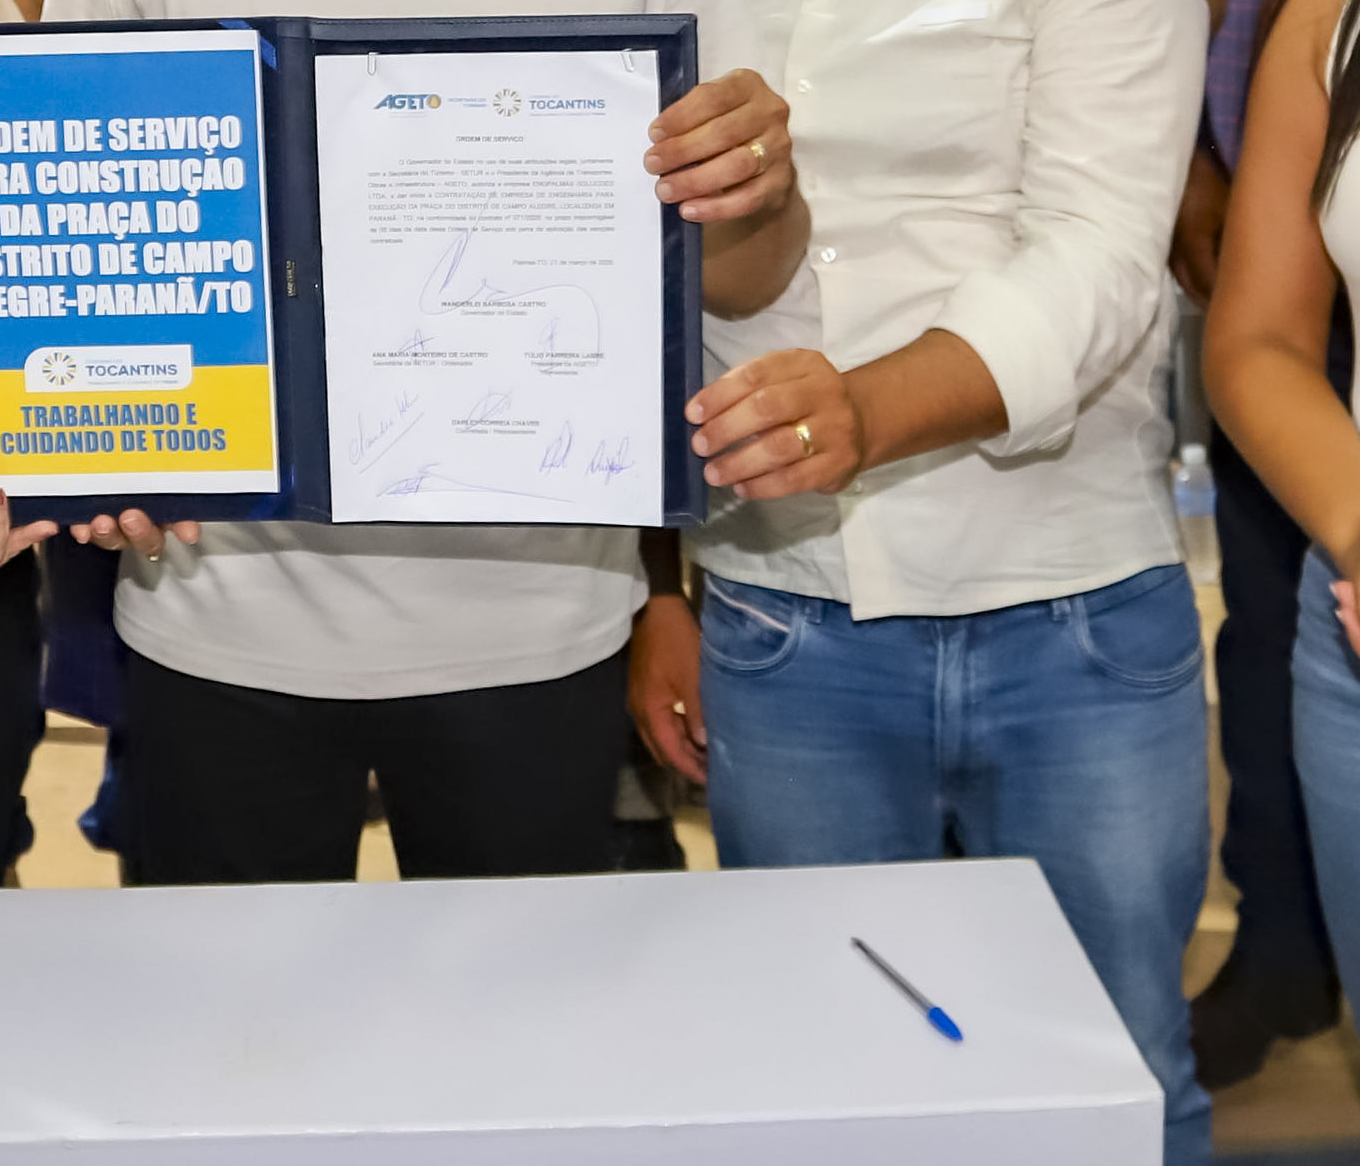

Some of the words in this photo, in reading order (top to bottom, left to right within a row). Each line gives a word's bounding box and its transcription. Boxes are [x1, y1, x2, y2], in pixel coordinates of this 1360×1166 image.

[528, 99, 606, 110] TOCANTINS
[64, 119, 104, 153] DE
[109, 115, 241, 156] SERVIÇO
[0, 203, 43, 237] DA
[47, 199, 152, 242] PRAÇA
[156, 198, 200, 234] DO
[99, 241, 138, 276] DE
[142, 238, 254, 277] CAMPO
[85, 364, 179, 377] TOCANTINS
[20, 404, 180, 428] TRABALHANDO
[186, 403, 198, 425] E
[0, 430, 115, 456] CUIDANDO
[121, 429, 148, 453] DE
[154, 428, 227, 452] TODOS
